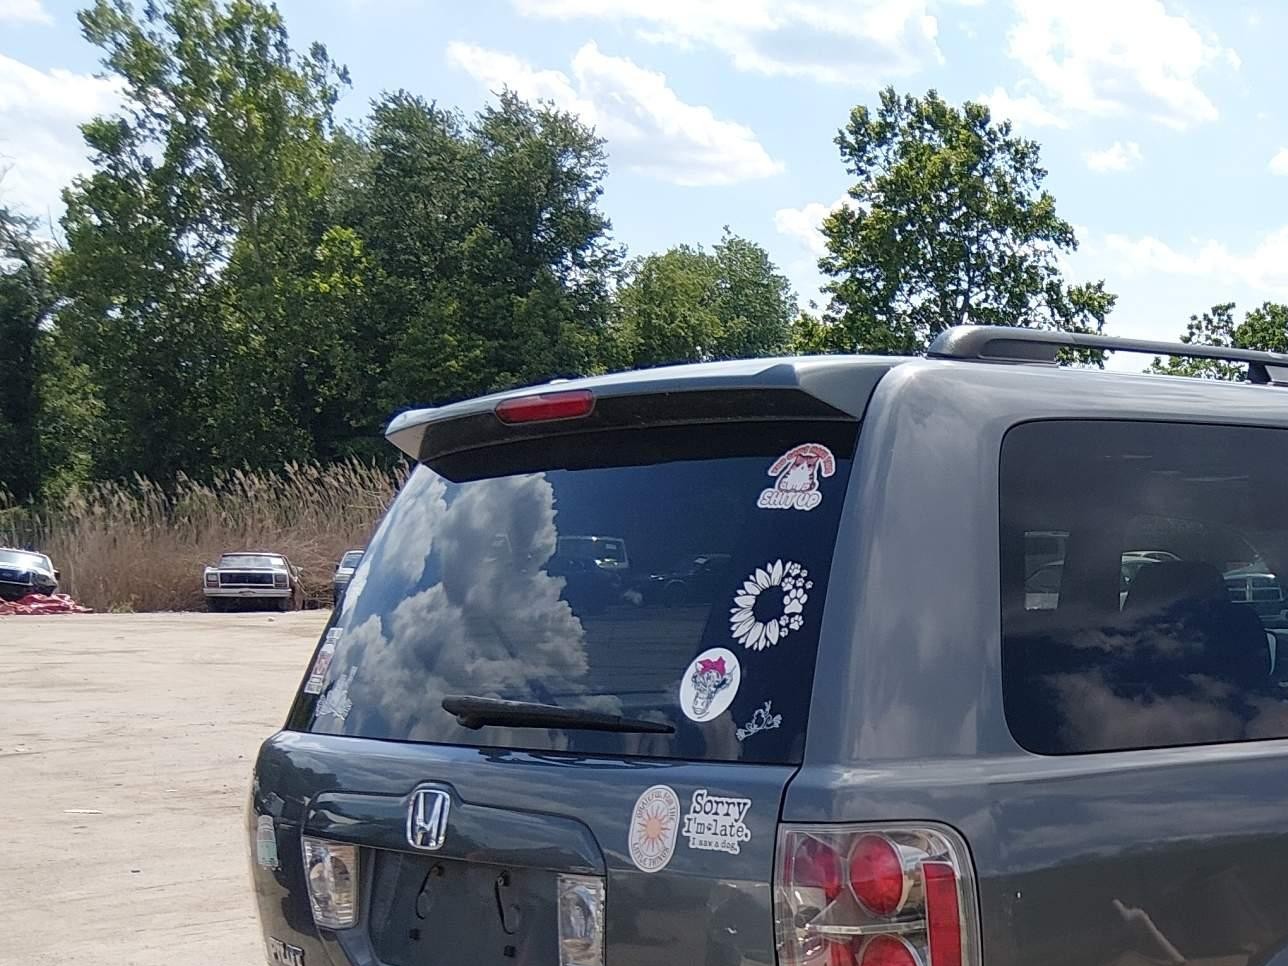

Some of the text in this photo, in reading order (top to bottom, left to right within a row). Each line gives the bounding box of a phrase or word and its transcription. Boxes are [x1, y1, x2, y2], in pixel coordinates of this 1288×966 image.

[796, 492, 820, 508] UP
[692, 792, 749, 823] Sorry
[684, 817, 749, 839] I'm late.
